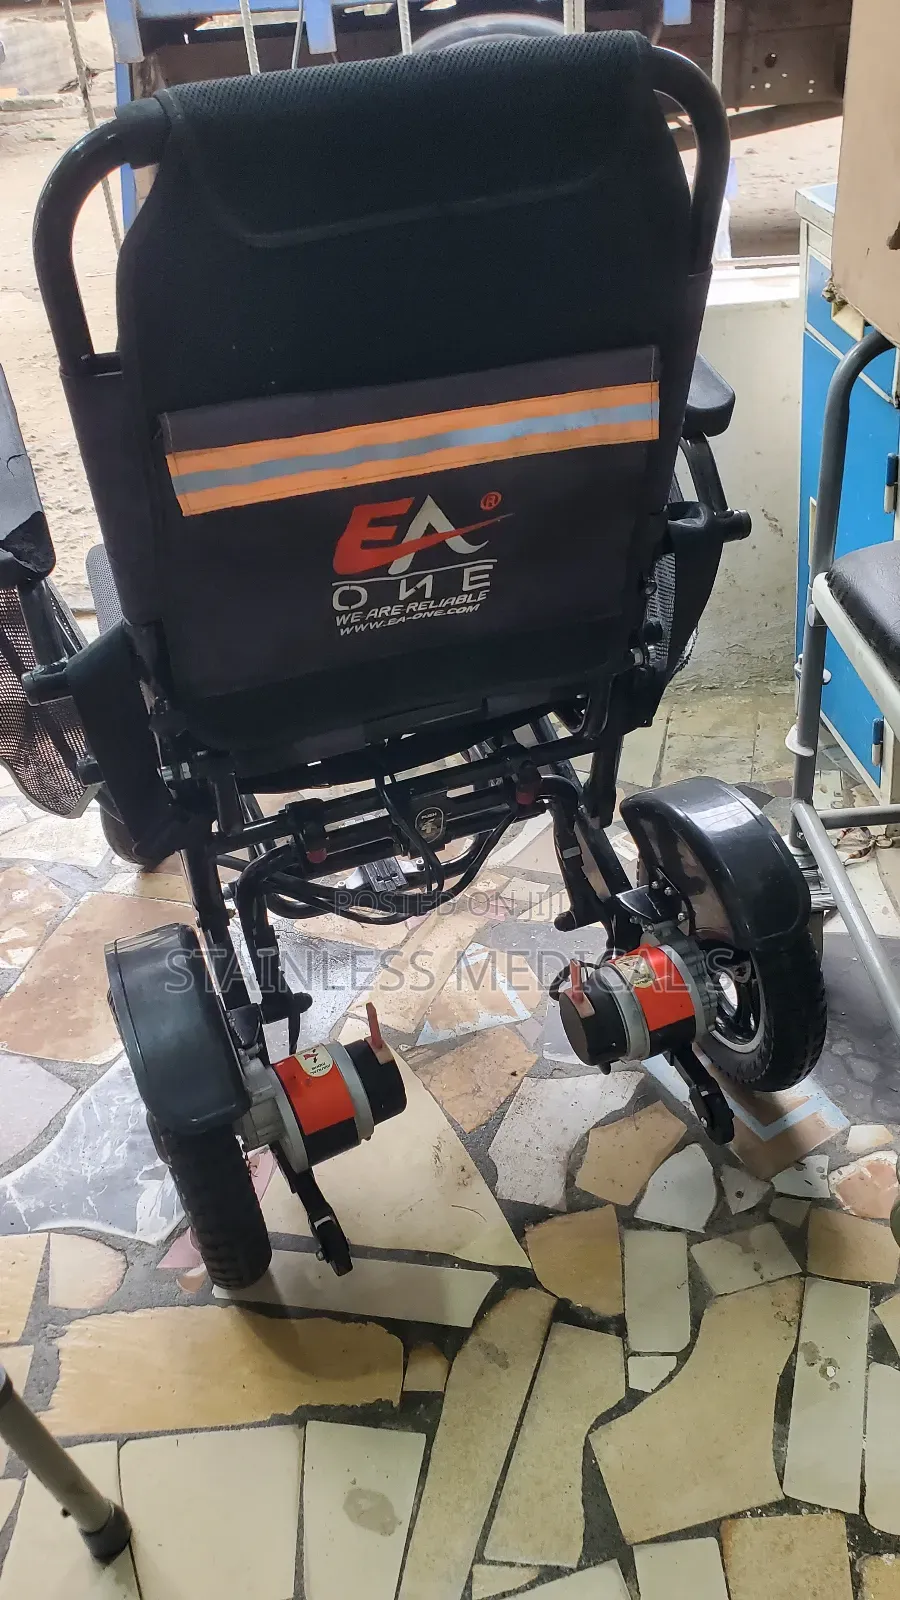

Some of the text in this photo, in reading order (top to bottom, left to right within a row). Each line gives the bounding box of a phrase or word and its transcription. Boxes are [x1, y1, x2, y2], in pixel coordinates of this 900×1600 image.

[333, 494, 489, 575] EA
[336, 590, 490, 626] WE ARE RELIABLE
[340, 603, 481, 636] WWW.EA-ONE.COM
